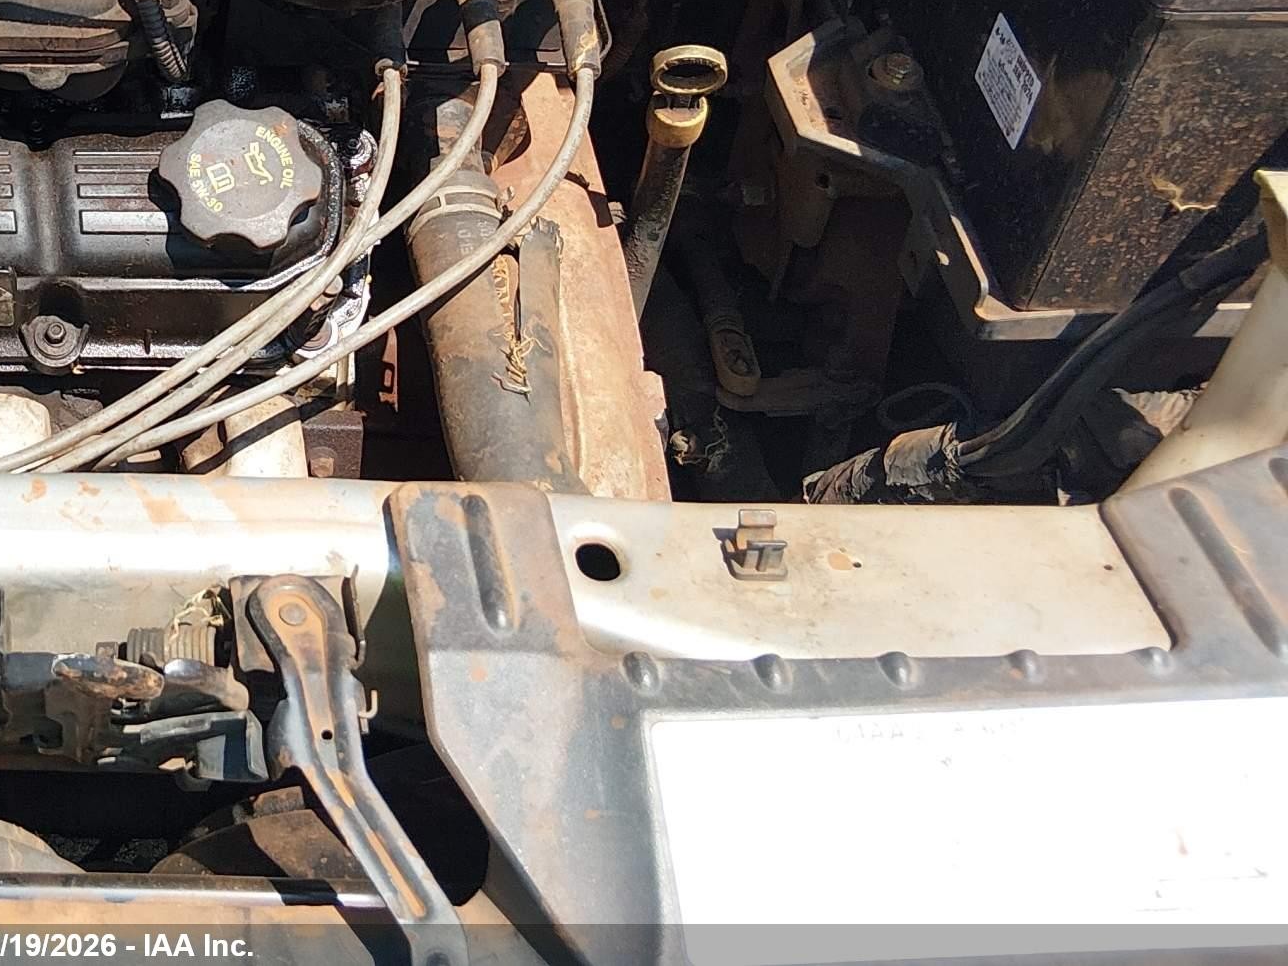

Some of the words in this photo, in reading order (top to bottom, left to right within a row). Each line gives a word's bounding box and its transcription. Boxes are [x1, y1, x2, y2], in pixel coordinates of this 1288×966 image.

[189, 153, 202, 178] SAE
[255, 125, 293, 167] ENGINE
[279, 168, 294, 189] OIL
[192, 178, 224, 212] 5W-30
